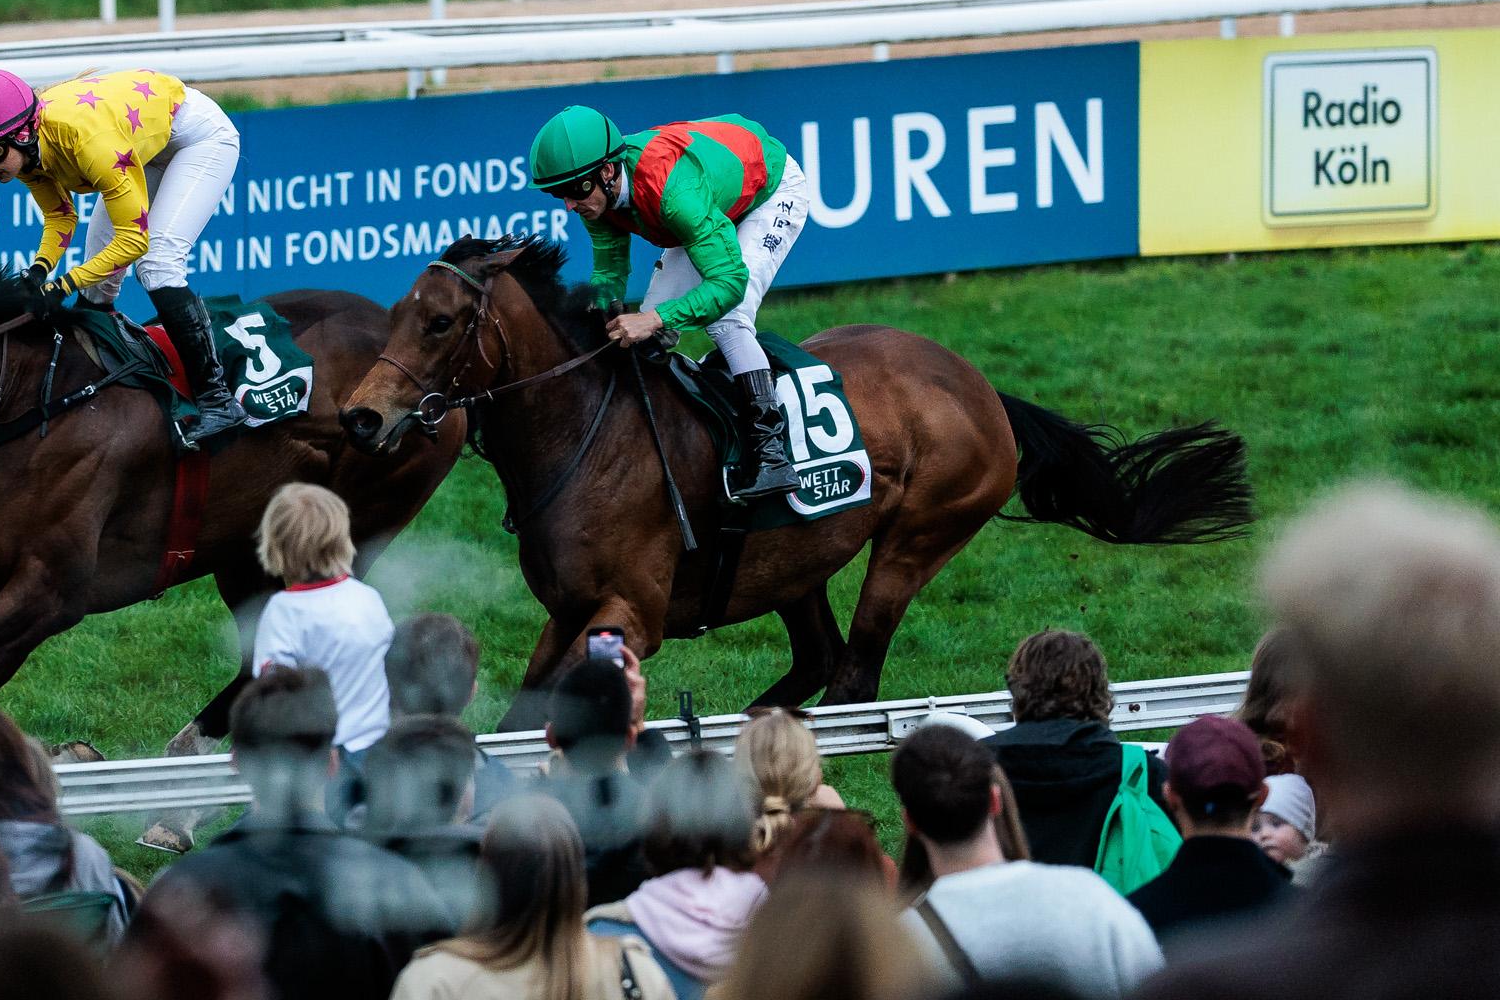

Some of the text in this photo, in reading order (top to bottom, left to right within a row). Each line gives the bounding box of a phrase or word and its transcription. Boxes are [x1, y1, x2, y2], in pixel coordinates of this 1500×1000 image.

[1302, 86, 1402, 129] Radio
[247, 172, 355, 214] NICHT
[365, 167, 402, 203] IN
[414, 156, 528, 199] FONDS
[801, 98, 1105, 228] UREN
[1313, 145, 1392, 187] Köln
[236, 235, 272, 271] IN
[285, 208, 569, 266] FONDSMANAGER
[224, 312, 282, 384] 5
[251, 382, 290, 404] WETT
[774, 364, 854, 462] 15
[799, 467, 841, 489] WETT
[813, 479, 850, 500] STAR
